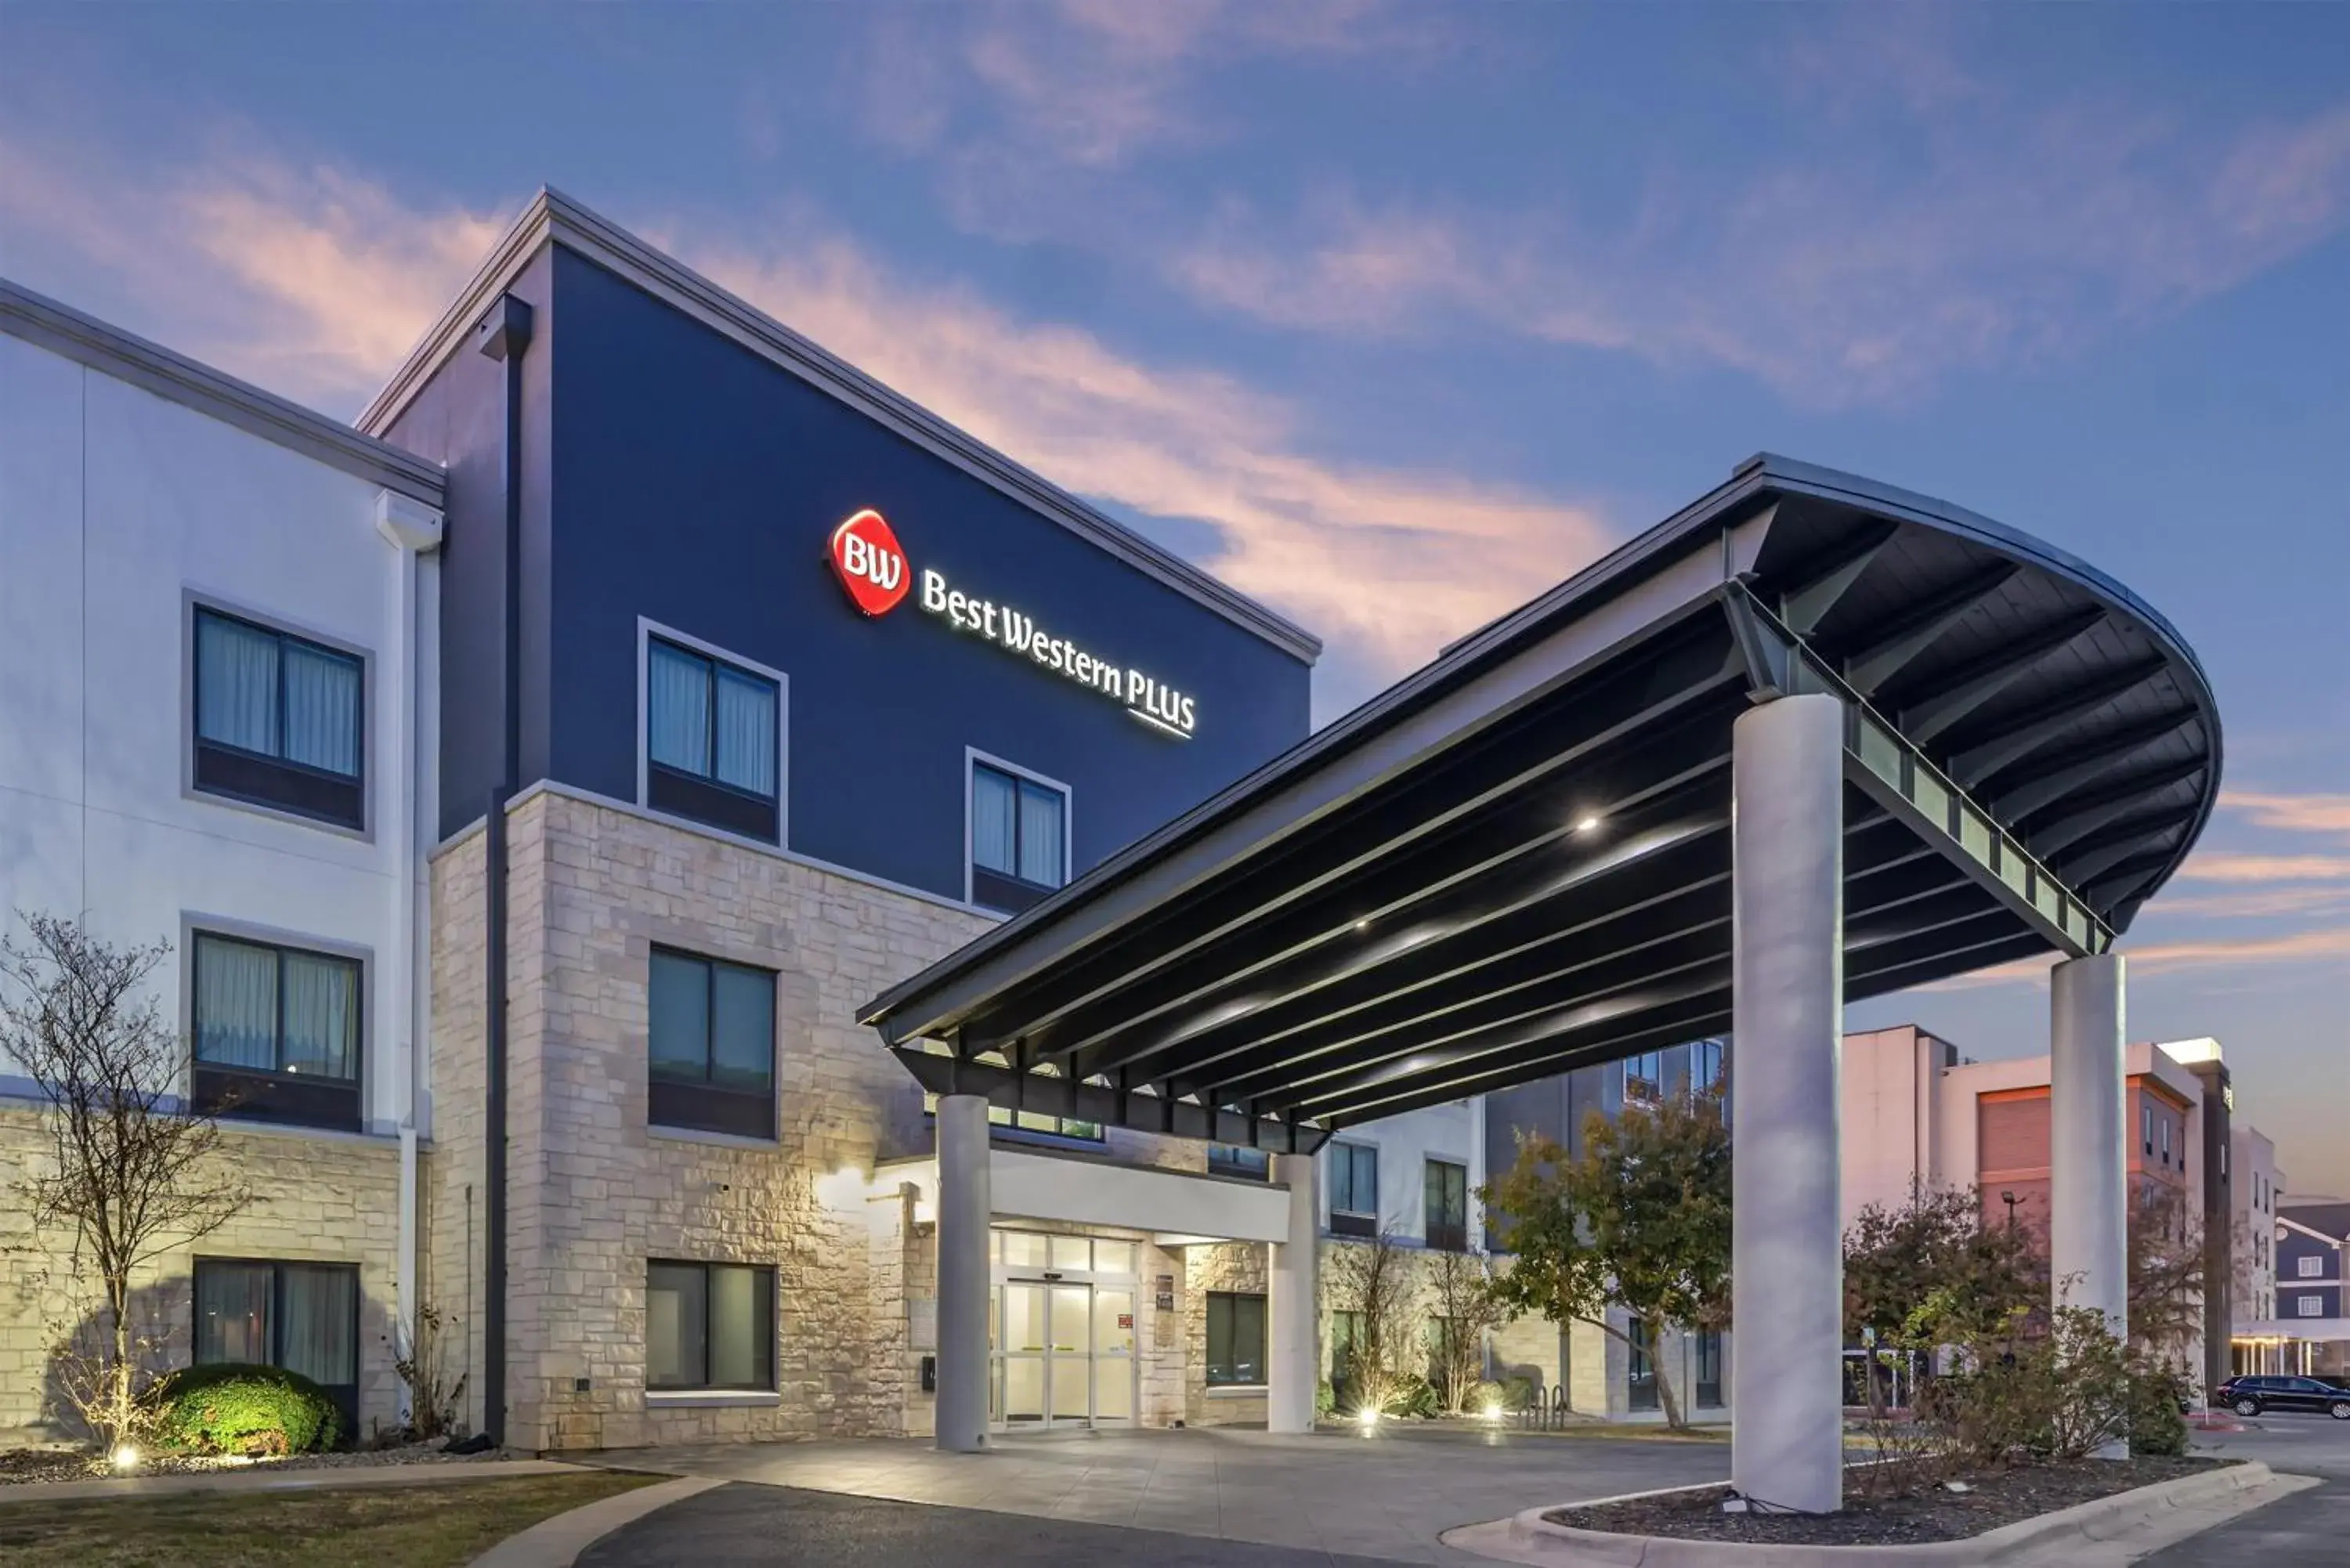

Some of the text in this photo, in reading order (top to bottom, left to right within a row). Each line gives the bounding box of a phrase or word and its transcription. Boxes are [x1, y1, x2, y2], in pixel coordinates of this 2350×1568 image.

[844, 533, 901, 590] BW
[923, 569, 1195, 731] Best Western PLUS
